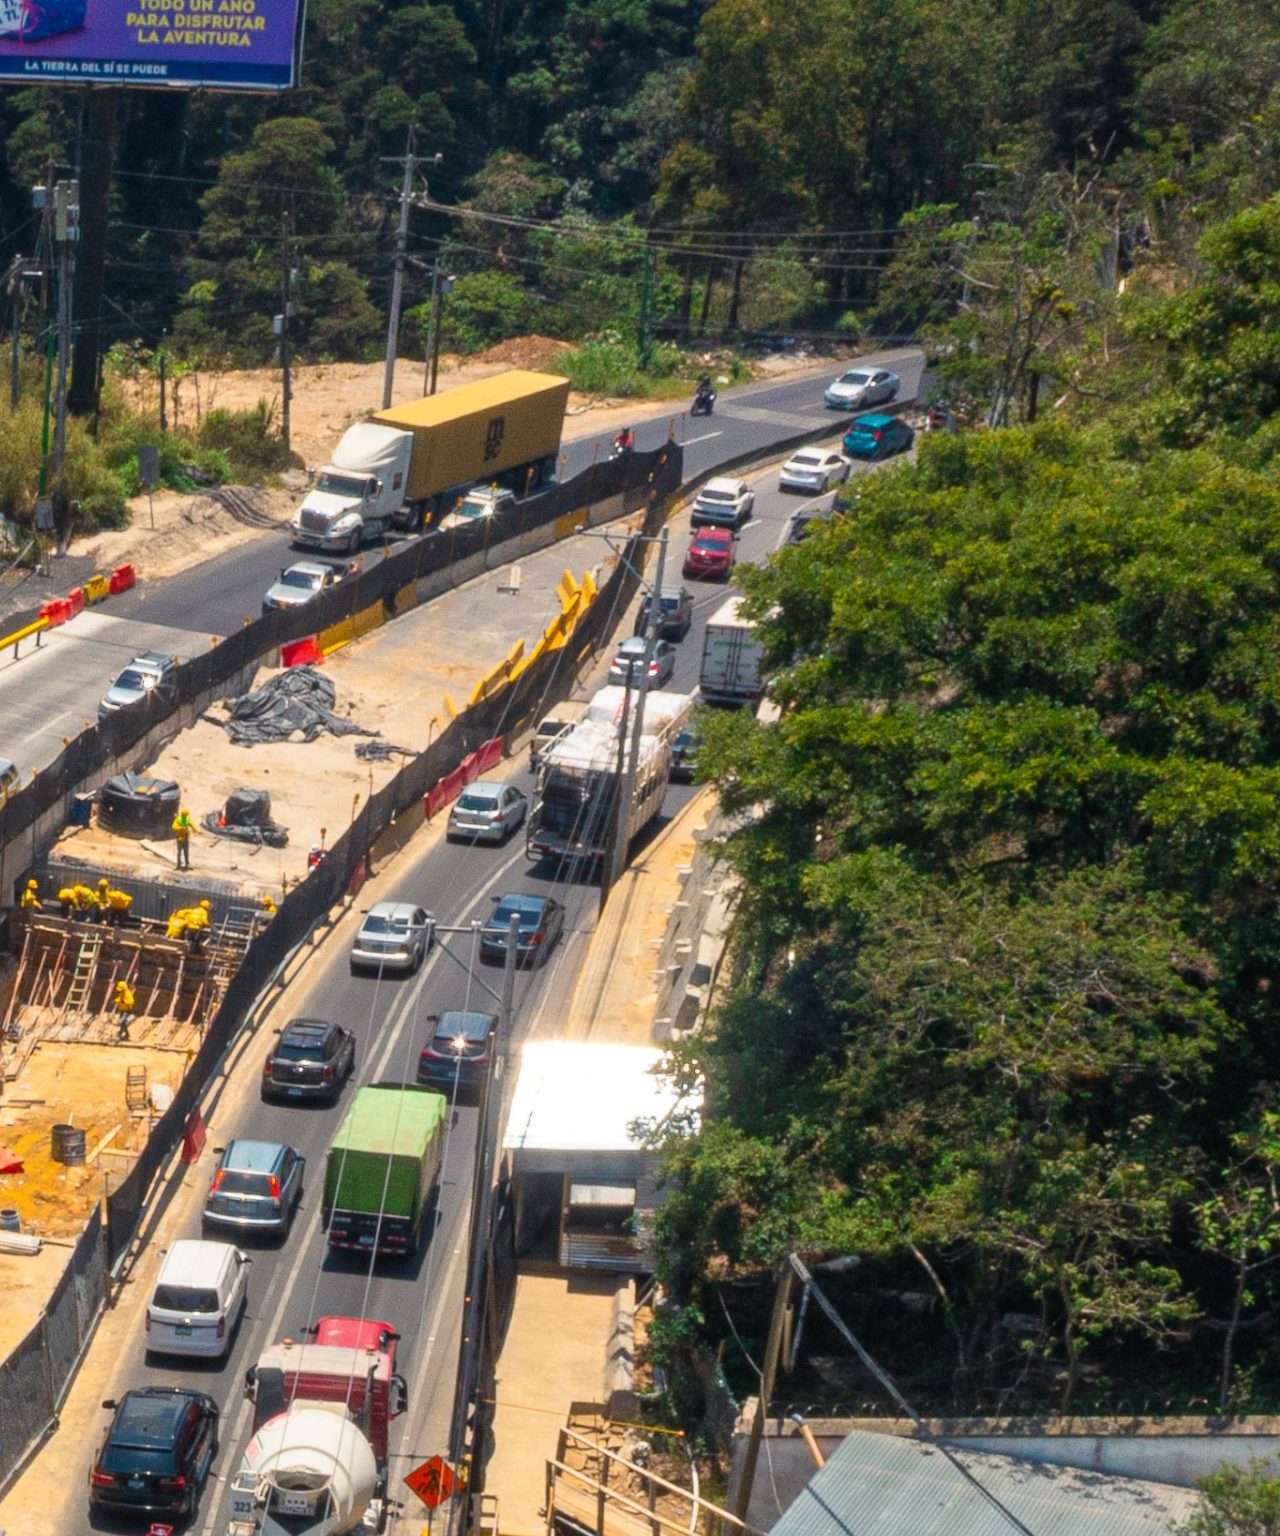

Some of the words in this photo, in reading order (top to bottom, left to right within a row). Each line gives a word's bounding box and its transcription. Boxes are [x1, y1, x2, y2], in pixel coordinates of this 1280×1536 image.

[140, 0, 184, 11] TODO
[190, 0, 213, 11] UN
[3, 9, 20, 21] TI.
[126, 12, 169, 28] PARA
[175, 14, 266, 30] DISFRUTAR
[138, 29, 159, 43] LA
[164, 31, 251, 46] AVENTURA
[24, 60, 39, 71] LA
[41, 61, 79, 72] TIERRA
[81, 62, 101, 73] DEL
[116, 64, 130, 74] SE
[132, 65, 168, 75] PUEDE
